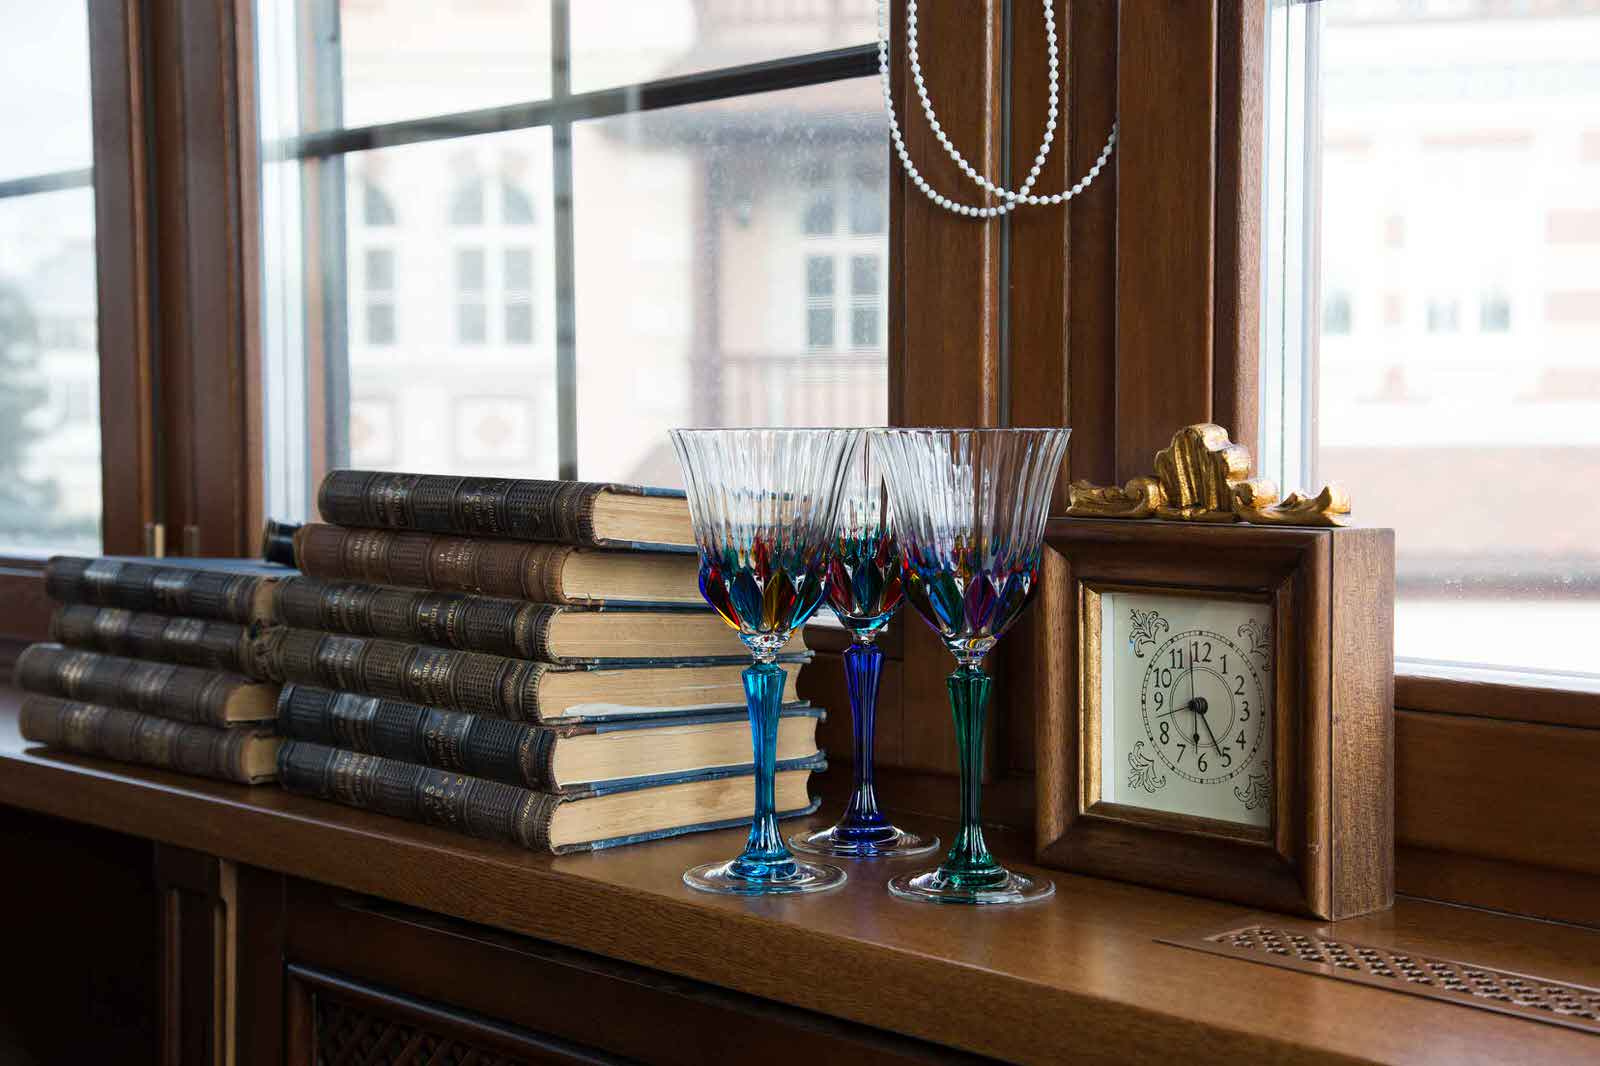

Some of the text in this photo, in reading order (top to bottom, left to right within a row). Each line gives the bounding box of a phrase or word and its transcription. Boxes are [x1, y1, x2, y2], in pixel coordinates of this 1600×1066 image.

[1169, 649, 1185, 669] 11
[1192, 641, 1212, 663] 12
[1220, 654, 1228, 674] 1
[1153, 668, 1172, 688] 10
[1234, 675, 1245, 695] 2
[1154, 692, 1164, 711] 9
[1240, 701, 1250, 722] 3
[1160, 721, 1169, 744] 8
[1236, 729, 1246, 750] 4
[1176, 743, 1186, 763] 7
[1198, 753, 1208, 773] 6
[1221, 747, 1231, 767] 5
